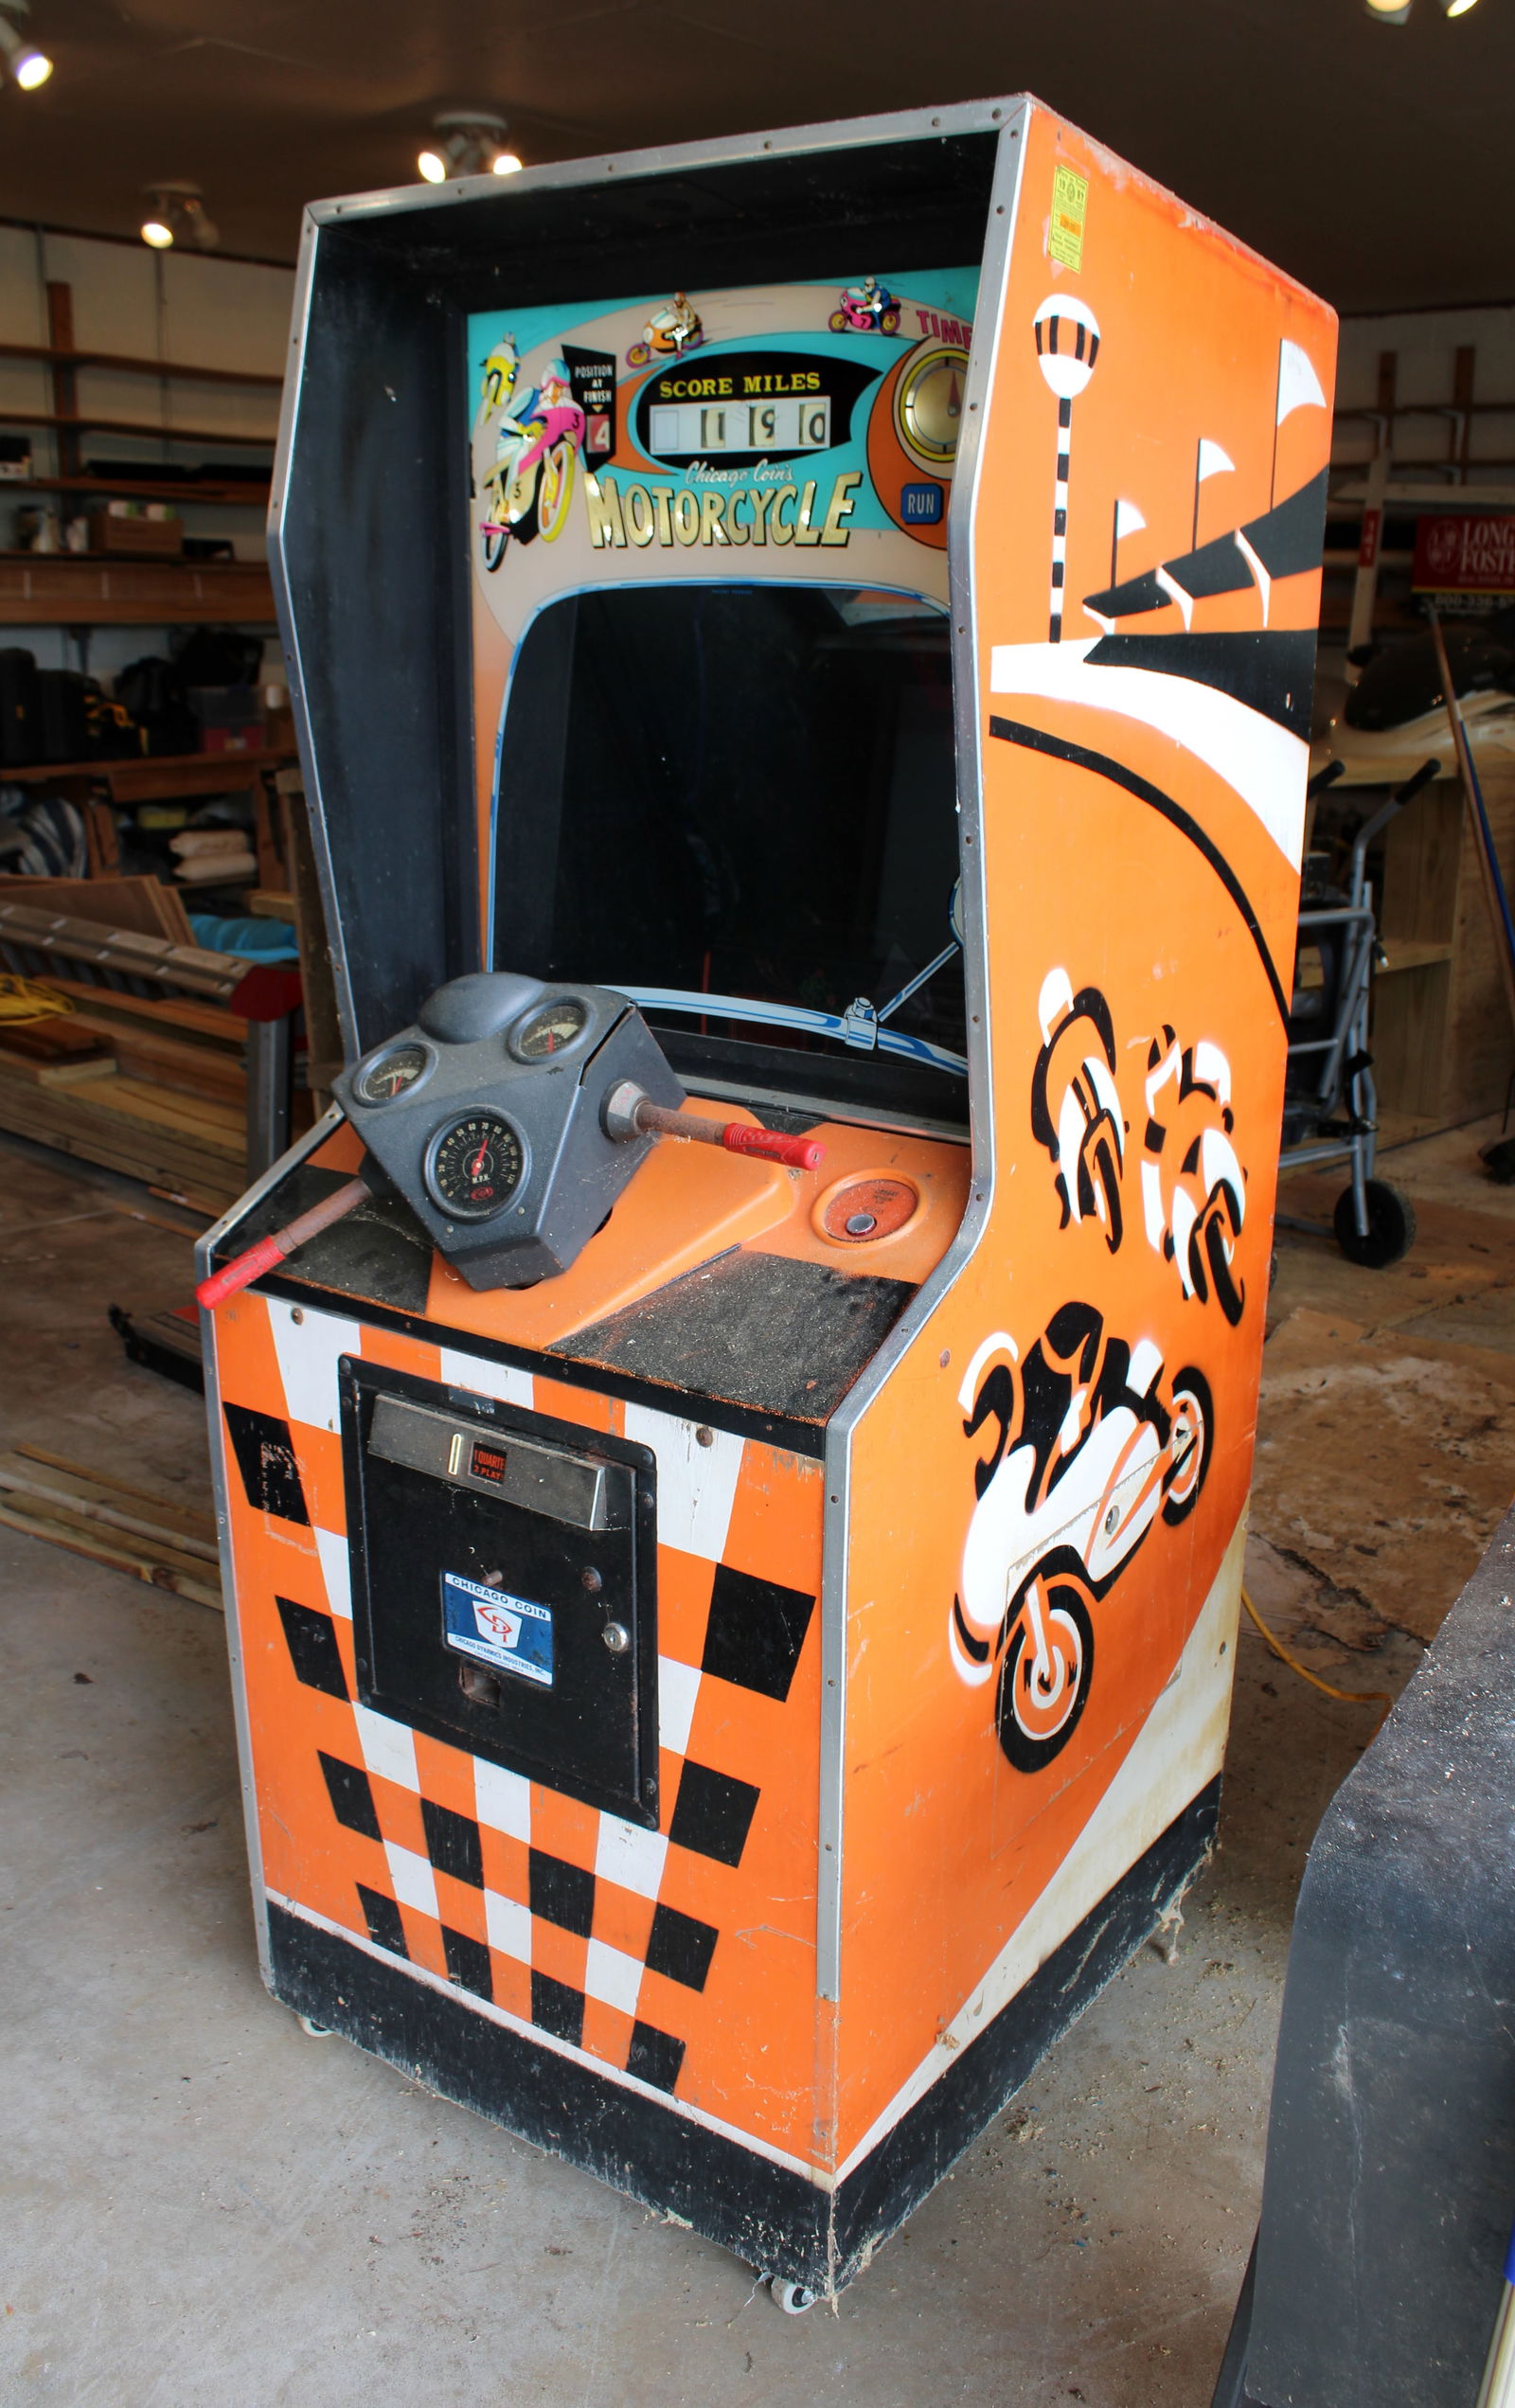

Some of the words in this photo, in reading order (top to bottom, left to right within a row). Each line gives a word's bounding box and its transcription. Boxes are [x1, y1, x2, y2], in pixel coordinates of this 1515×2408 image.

[575, 365, 614, 378] POSITION
[592, 379, 603, 388] AT
[583, 390, 612, 403] FINISH
[659, 378, 734, 399] SCORE
[743, 372, 821, 393] MILES
[594, 420, 611, 452] 4
[685, 460, 748, 488] Chicago
[753, 458, 795, 482] Coin's
[583, 471, 864, 548] MOTORCYCLE
[906, 493, 936, 515] RUN
[452, 1577, 508, 1604] CHICAGO
[514, 1600, 546, 1619] COIN
